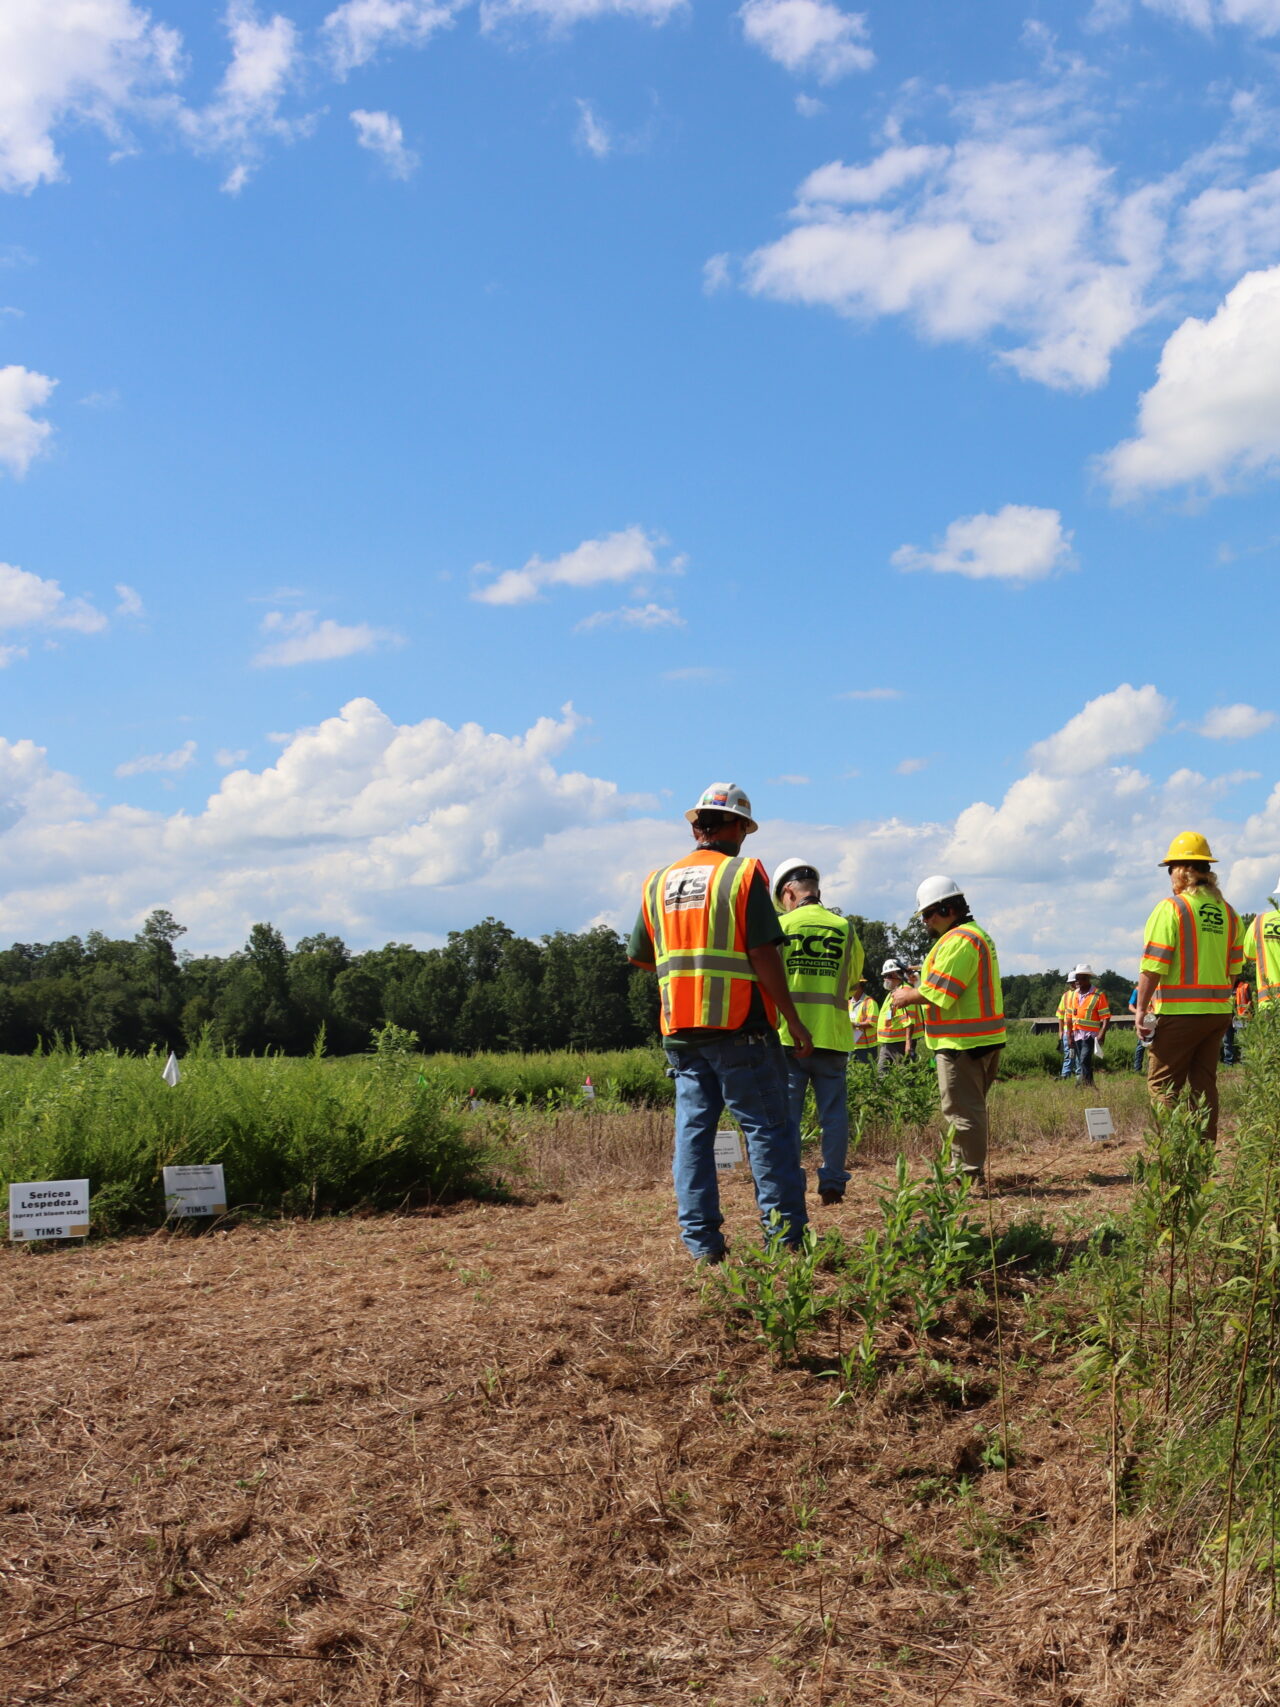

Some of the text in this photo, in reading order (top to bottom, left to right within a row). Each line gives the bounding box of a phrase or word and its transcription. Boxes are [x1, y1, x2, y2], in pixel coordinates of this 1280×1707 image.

[29, 1190, 71, 1199] Sericea
[21, 1199, 79, 1209] Lespedeza
[186, 1205, 208, 1214] TIMS
[34, 1227, 63, 1236] TIMS
